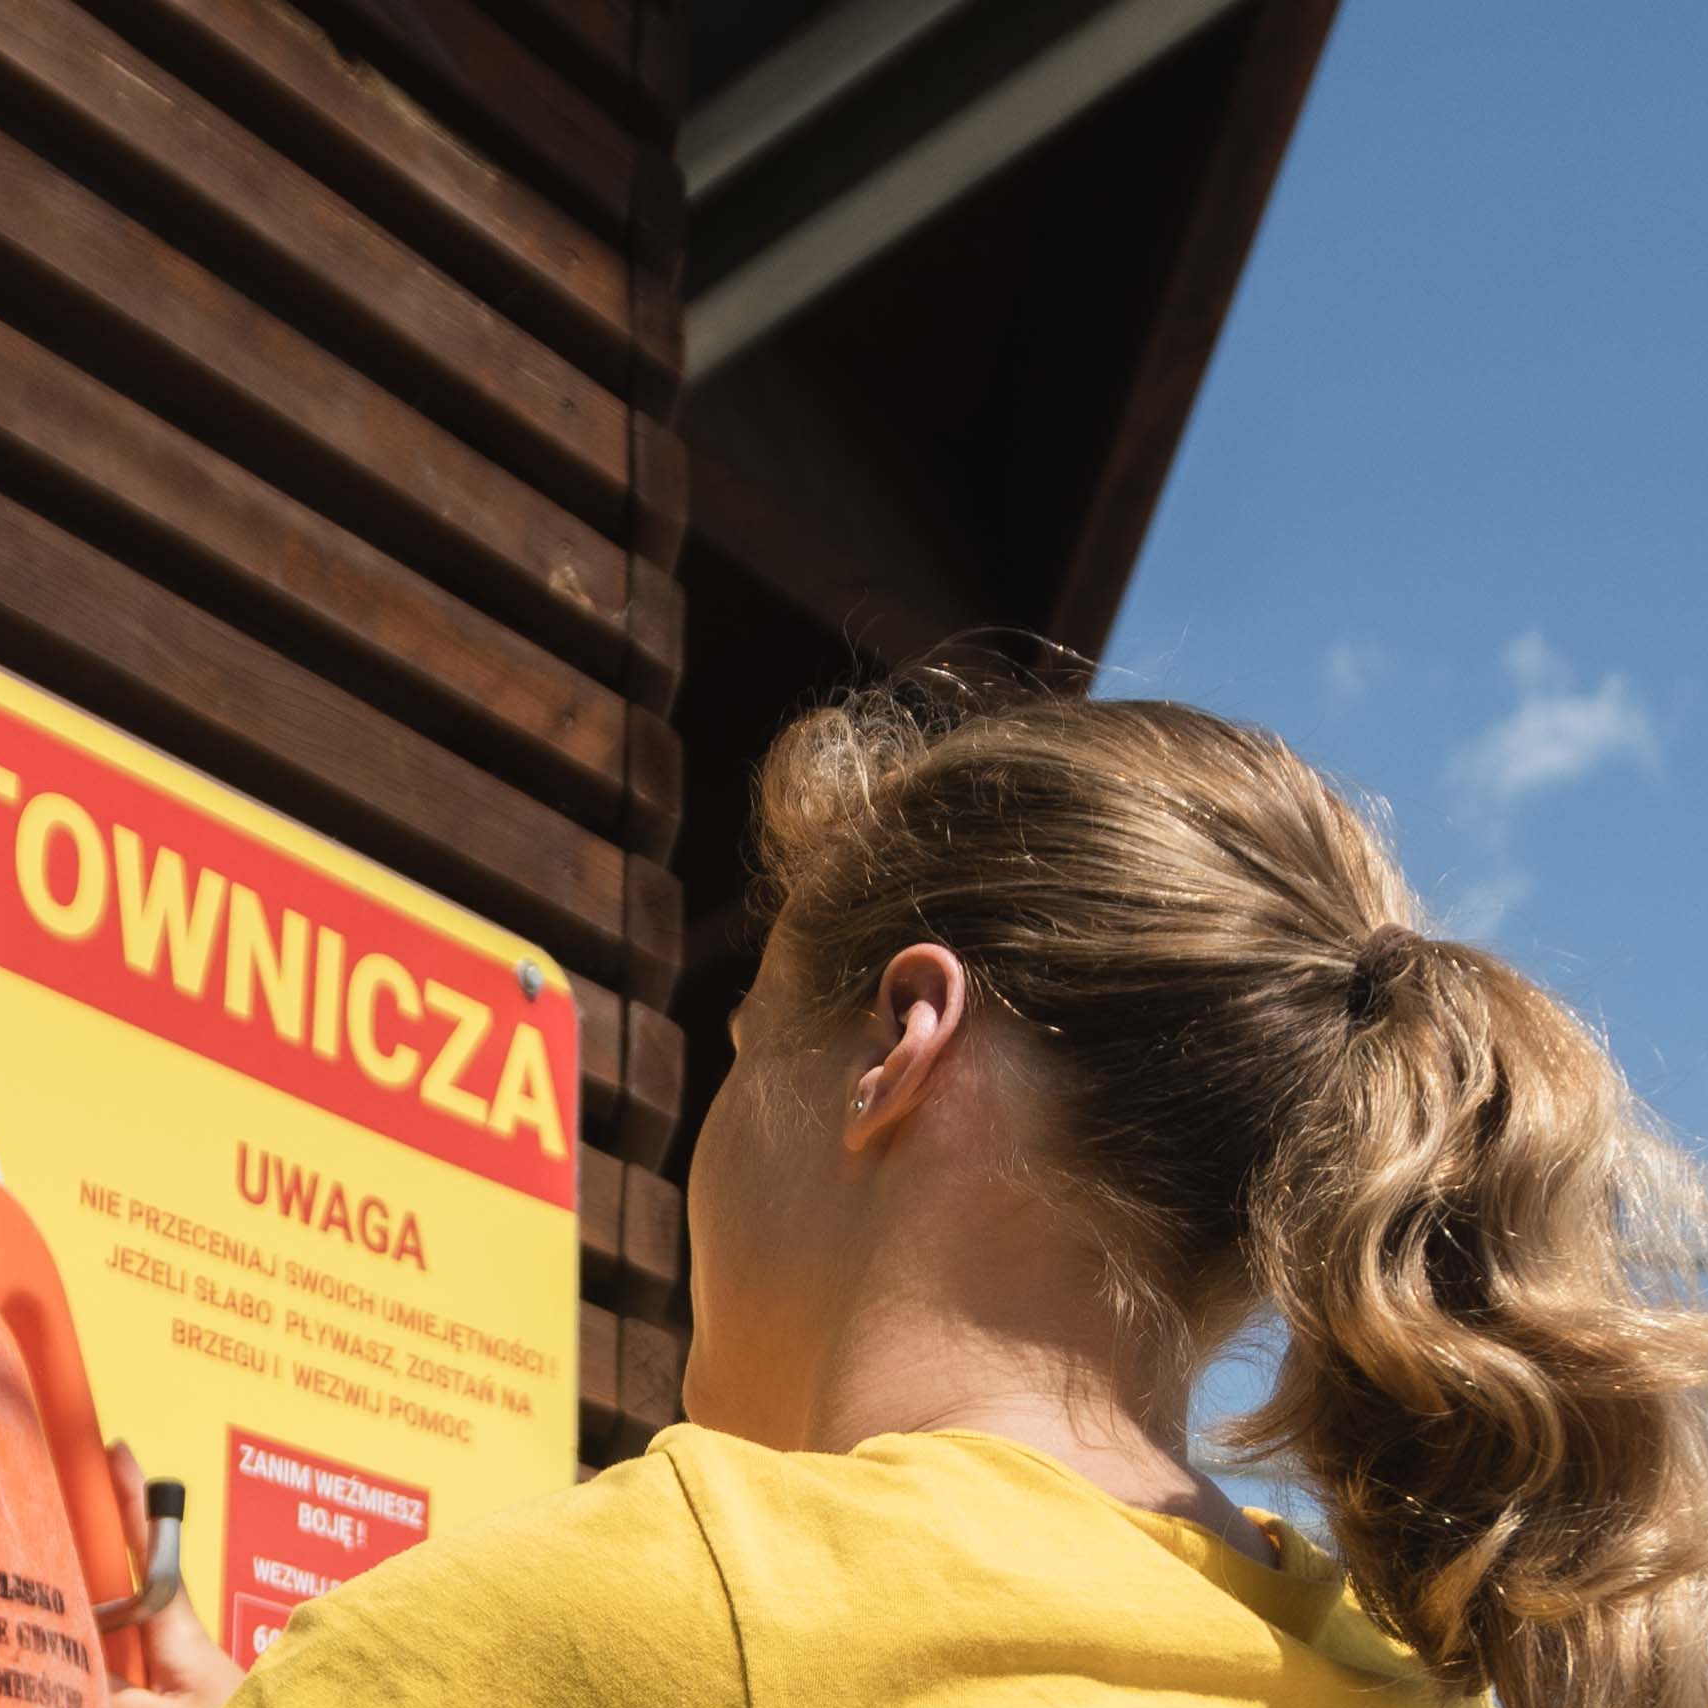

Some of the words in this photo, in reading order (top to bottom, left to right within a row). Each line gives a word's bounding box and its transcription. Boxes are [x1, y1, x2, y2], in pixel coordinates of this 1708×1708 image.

[237, 1141, 428, 1271] UWAGA
[79, 1179, 122, 1219] NIE
[128, 1195, 277, 1279] PRZECENIAJ
[285, 1260, 375, 1314] SWOICH
[381, 1294, 545, 1376] UMIEJĘTNOŚCI
[106, 1242, 187, 1296] JEŻELI
[193, 1276, 273, 1327] SŁABO
[285, 1311, 400, 1377] PŁYWASZ,
[407, 1355, 496, 1406] ZOSTAŃ
[501, 1385, 534, 1419] NA
[171, 1319, 267, 1375] BRZEGU
[293, 1364, 384, 1416] WEZWIJ
[388, 1396, 474, 1445] POMOC
[239, 1443, 312, 1490] ZANIM
[315, 1474, 425, 1528] WEŹMIESZ
[297, 1502, 354, 1553] BOJĘ
[252, 1554, 328, 1598] WEZWIJ
[15, 1621, 91, 1675] GDYNIA
